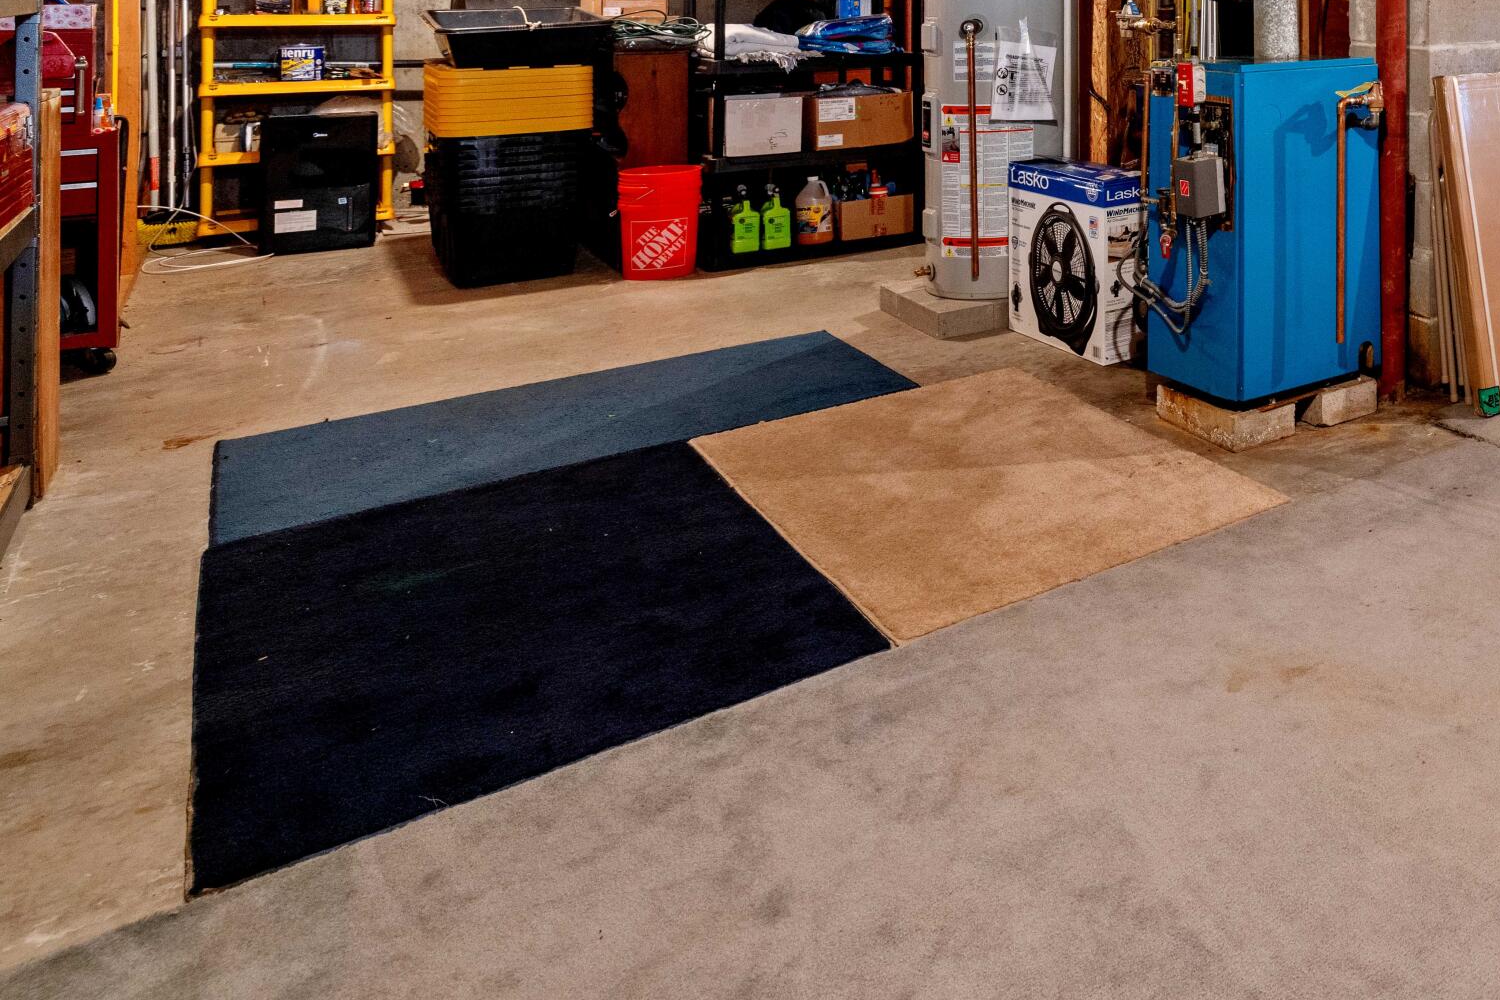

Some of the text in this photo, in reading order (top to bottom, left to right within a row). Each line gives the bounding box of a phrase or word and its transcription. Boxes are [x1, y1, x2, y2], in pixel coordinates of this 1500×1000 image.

[281, 49, 315, 60] Henry
[1010, 165, 1049, 190] Lasko
[1106, 186, 1142, 202] Lask
[632, 219, 687, 270] HOME
[635, 226, 660, 246] THE
[652, 235, 686, 269] DEPOT
